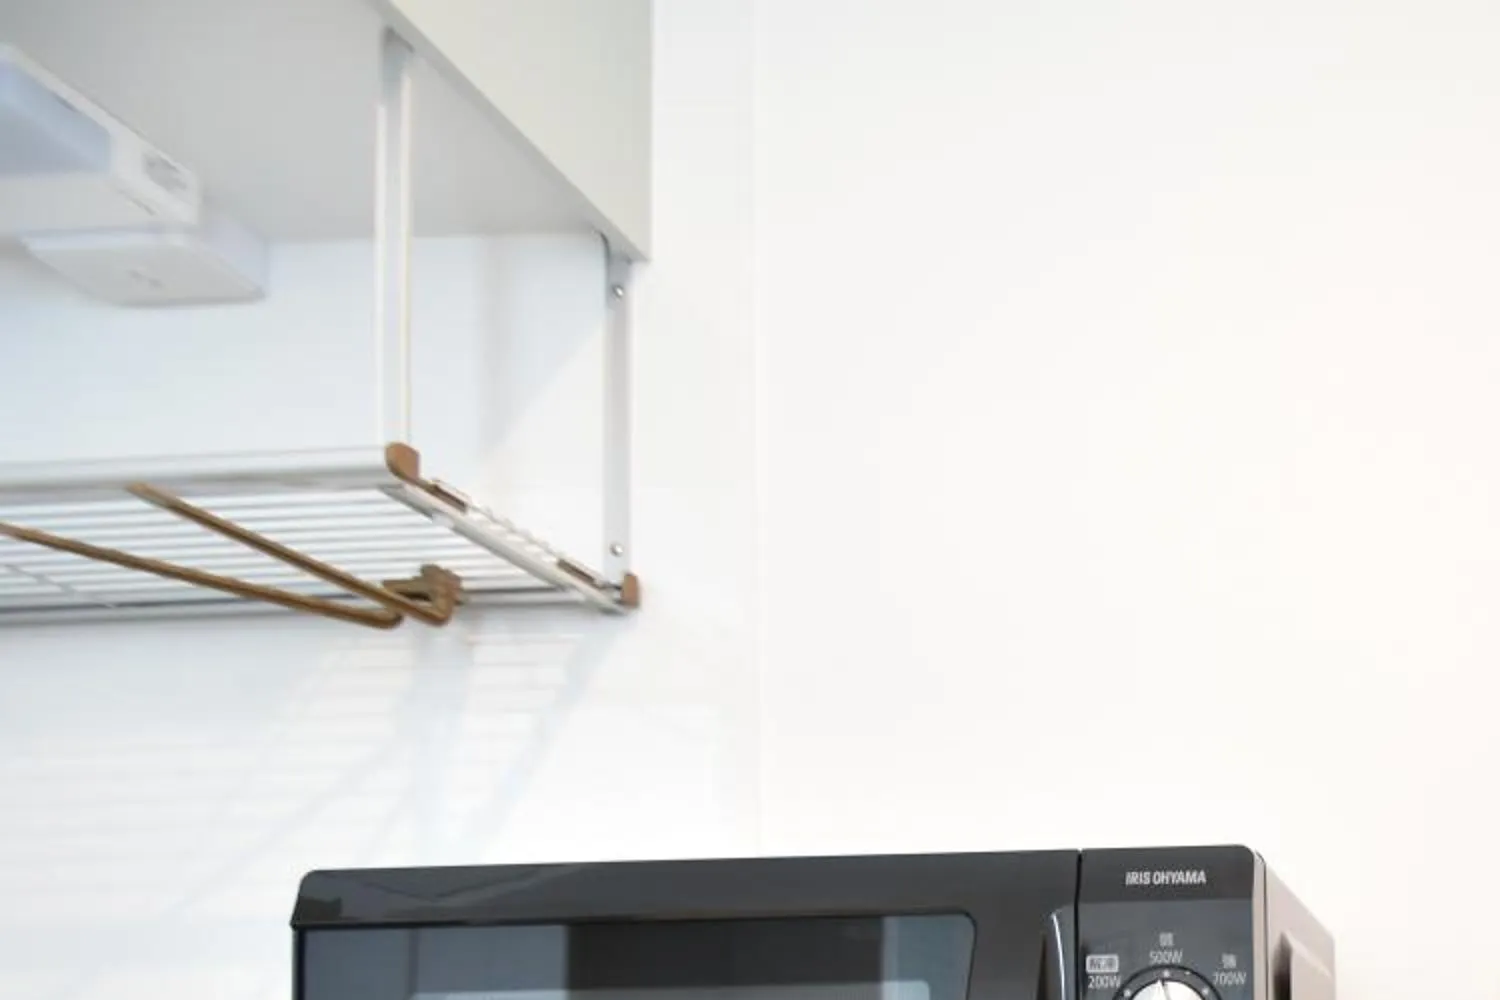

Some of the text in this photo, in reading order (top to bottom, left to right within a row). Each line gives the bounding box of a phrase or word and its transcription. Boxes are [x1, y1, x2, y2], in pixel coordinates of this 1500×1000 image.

[1125, 870, 1207, 886] IRIS OHYAMA
[1149, 950, 1183, 965] 500W
[1088, 976, 1121, 989] 200W
[1212, 971, 1247, 985] 700W
